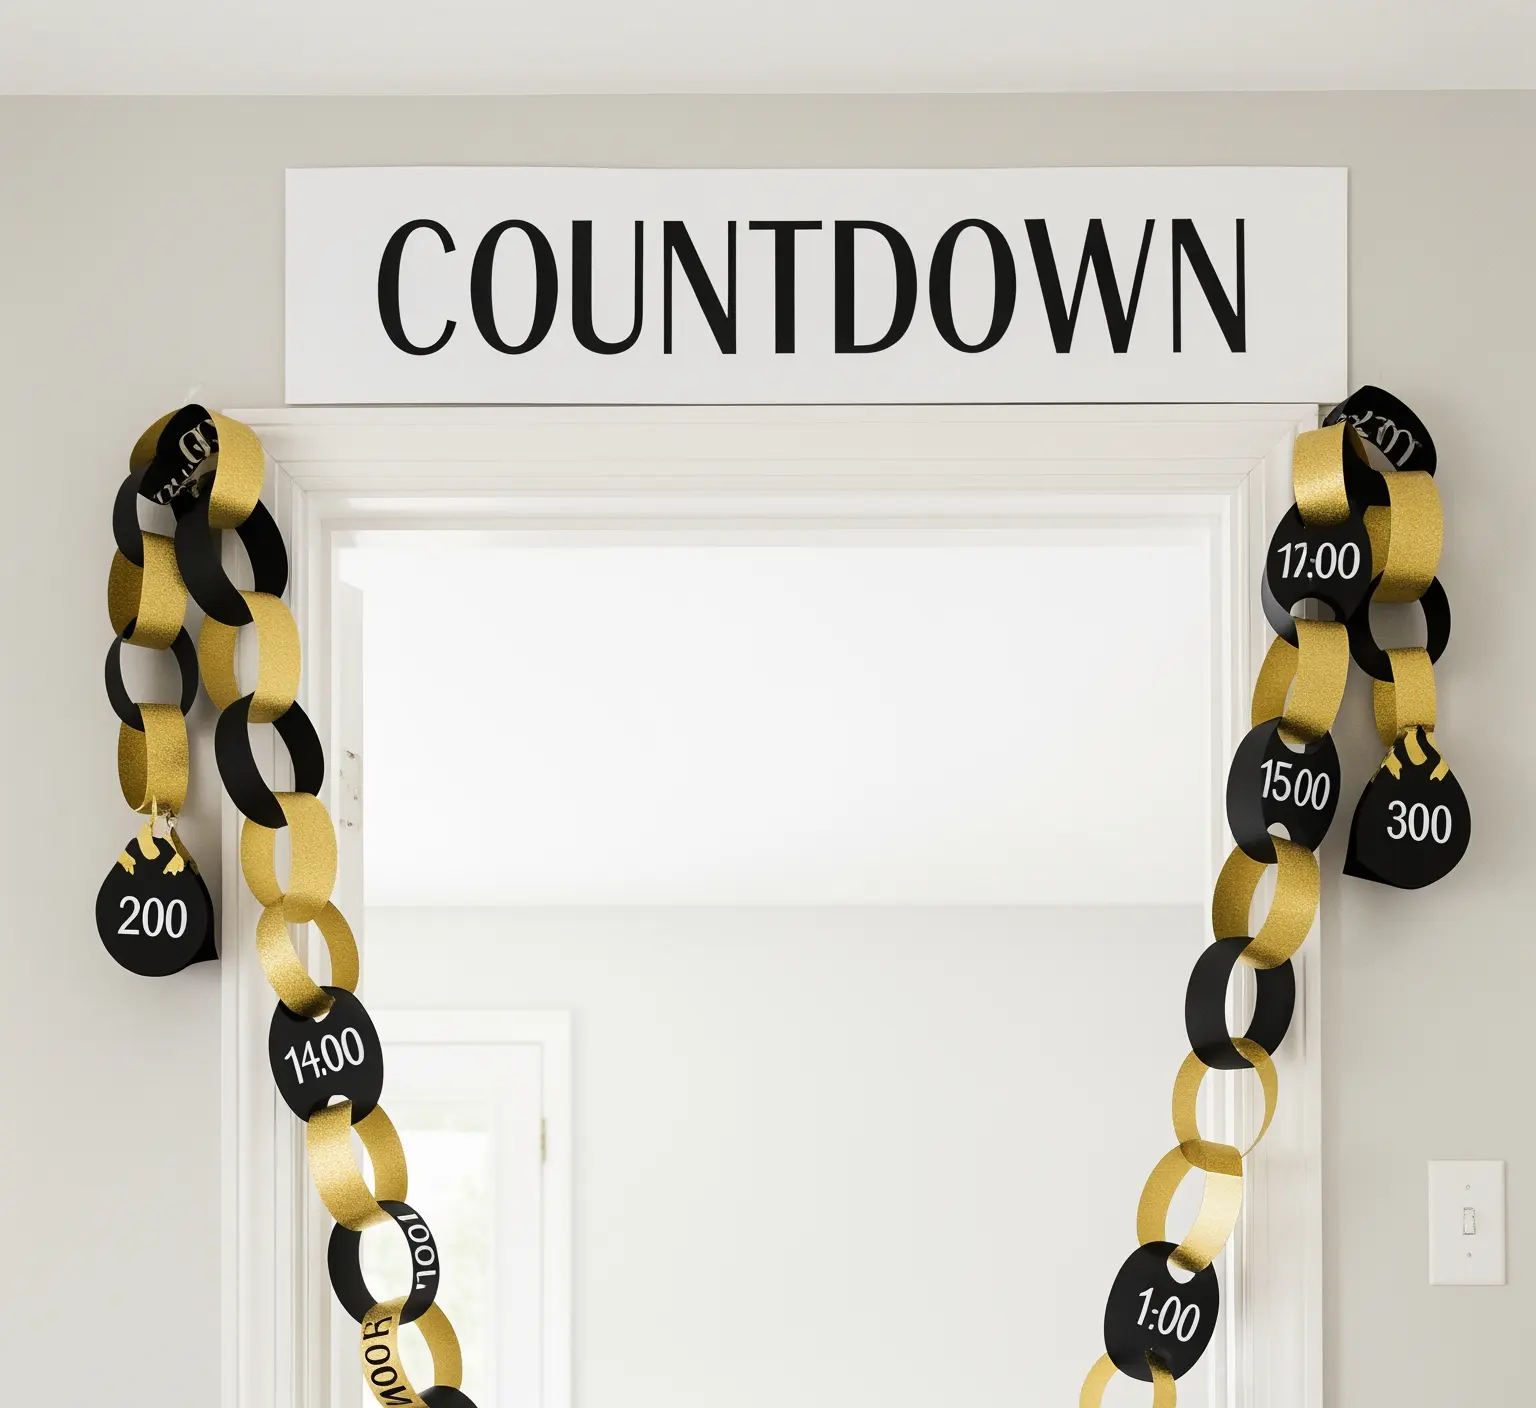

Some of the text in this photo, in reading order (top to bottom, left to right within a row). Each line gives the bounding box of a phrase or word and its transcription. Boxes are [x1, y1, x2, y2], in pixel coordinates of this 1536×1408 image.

[377, 218, 1248, 356] COUNTDOWN
[1386, 799, 1453, 844] 300
[117, 895, 188, 939] 200
[1136, 1287, 1201, 1343] 1:00
